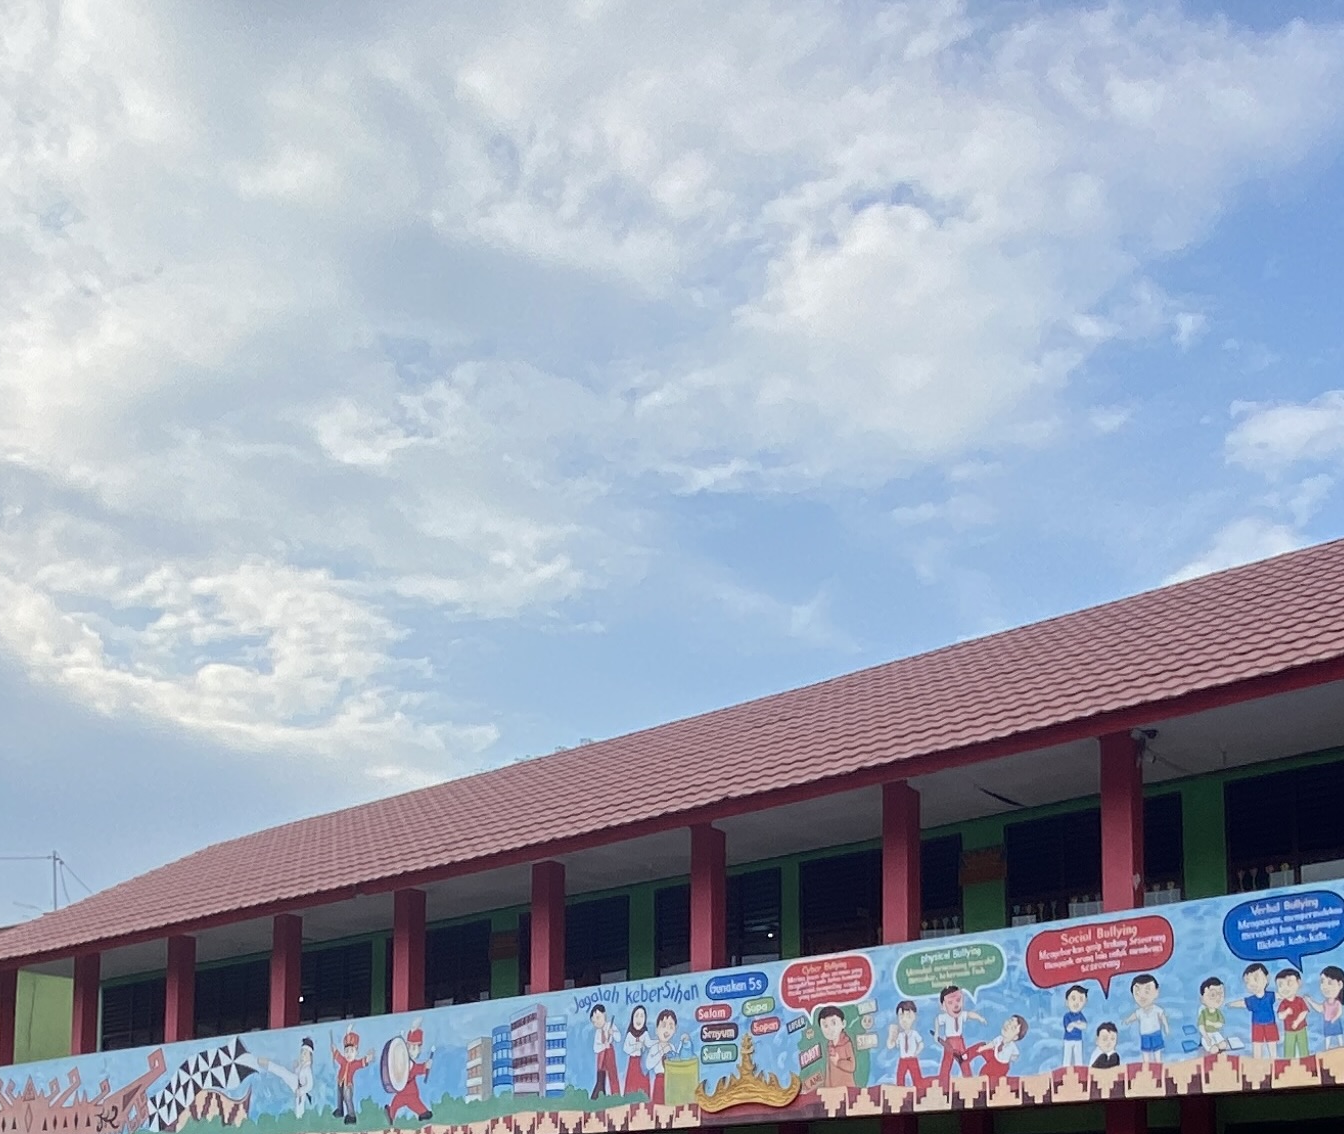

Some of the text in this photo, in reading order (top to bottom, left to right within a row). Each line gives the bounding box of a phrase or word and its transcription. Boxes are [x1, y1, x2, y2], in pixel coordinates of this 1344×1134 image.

[1060, 923, 1138, 946] Social Bullying
[573, 985, 620, 1014] Jagalah
[698, 1007, 726, 1019] Salam
[745, 1000, 768, 1013] Sapa
[753, 1020, 779, 1033] Sopan
[702, 1028, 735, 1041] Senyum
[703, 1048, 732, 1061] Santun
